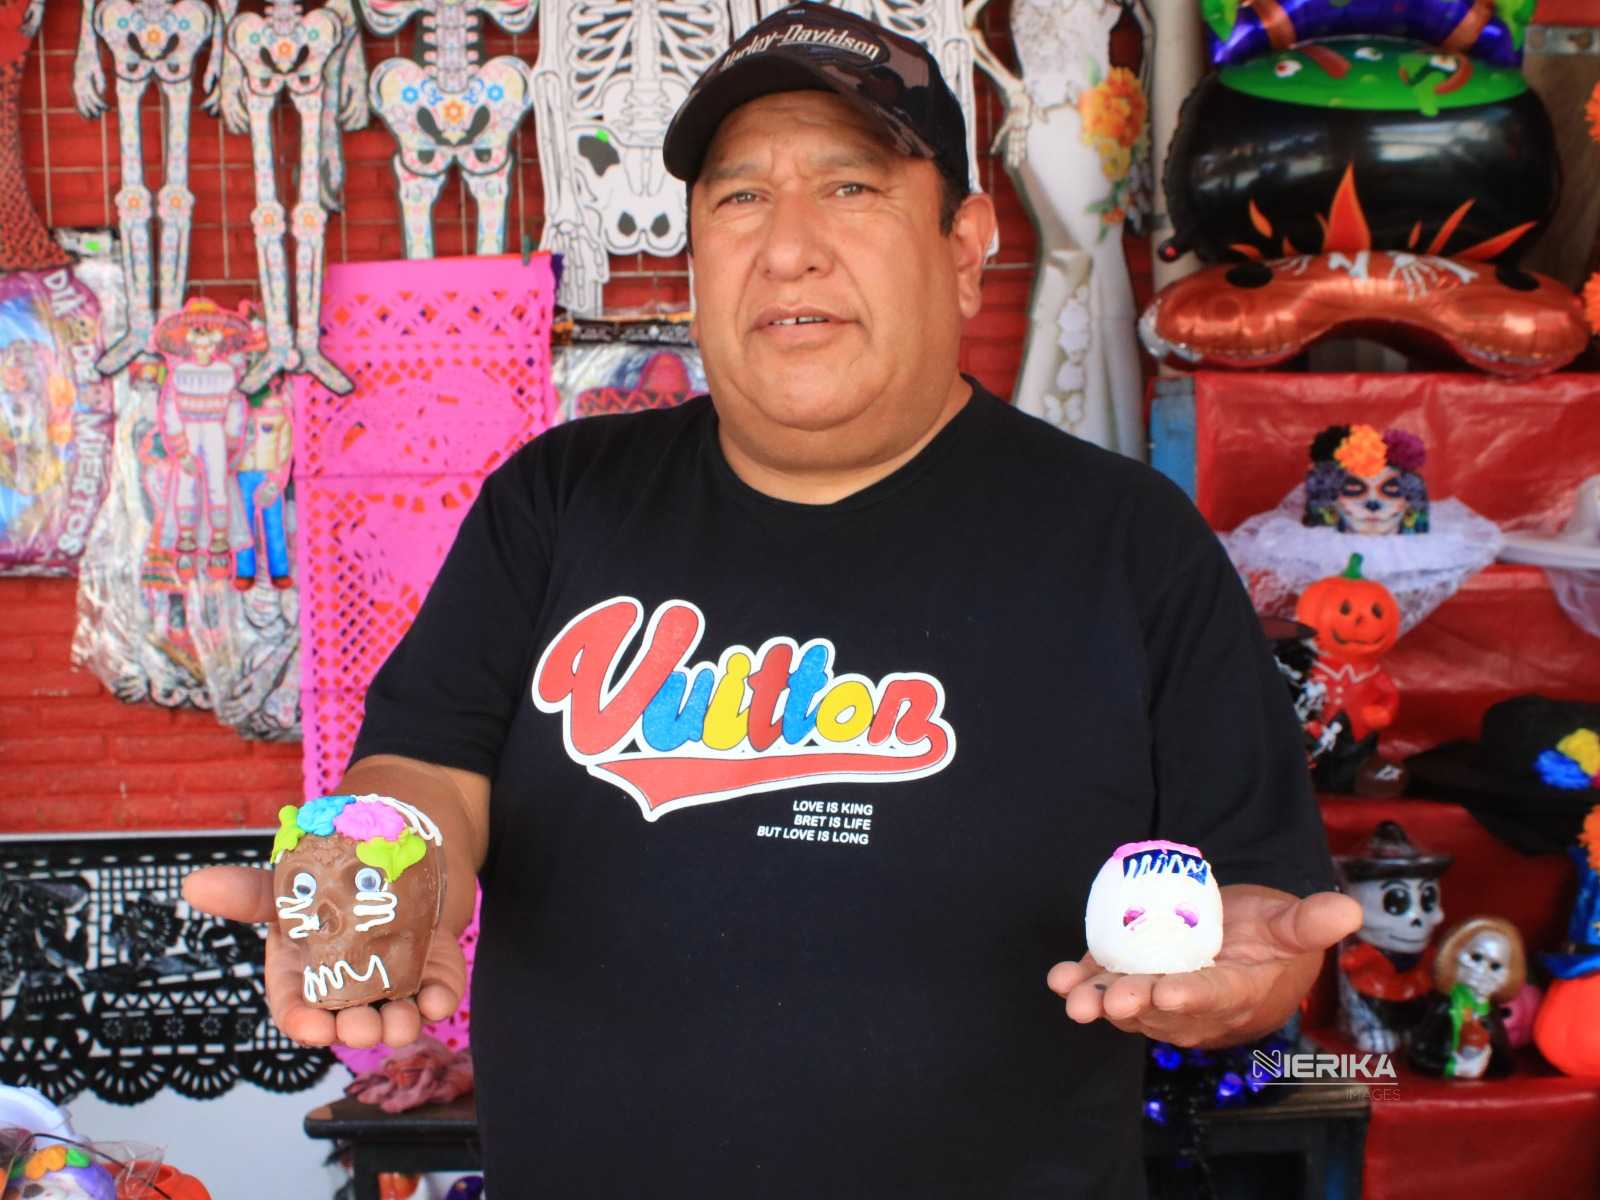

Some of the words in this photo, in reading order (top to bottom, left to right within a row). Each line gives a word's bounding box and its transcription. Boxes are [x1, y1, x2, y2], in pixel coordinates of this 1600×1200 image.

[532, 596, 957, 785] Vuitton
[792, 800, 825, 813] LOVE
[826, 801, 839, 814] IS
[841, 803, 874, 816] KING
[793, 814, 827, 827] BRET
[828, 817, 841, 829] IS
[843, 818, 872, 831] LIFE
[756, 825, 782, 838] BUT
[783, 828, 815, 841] LOVE
[817, 830, 830, 843] IS
[832, 832, 870, 846] LONG
